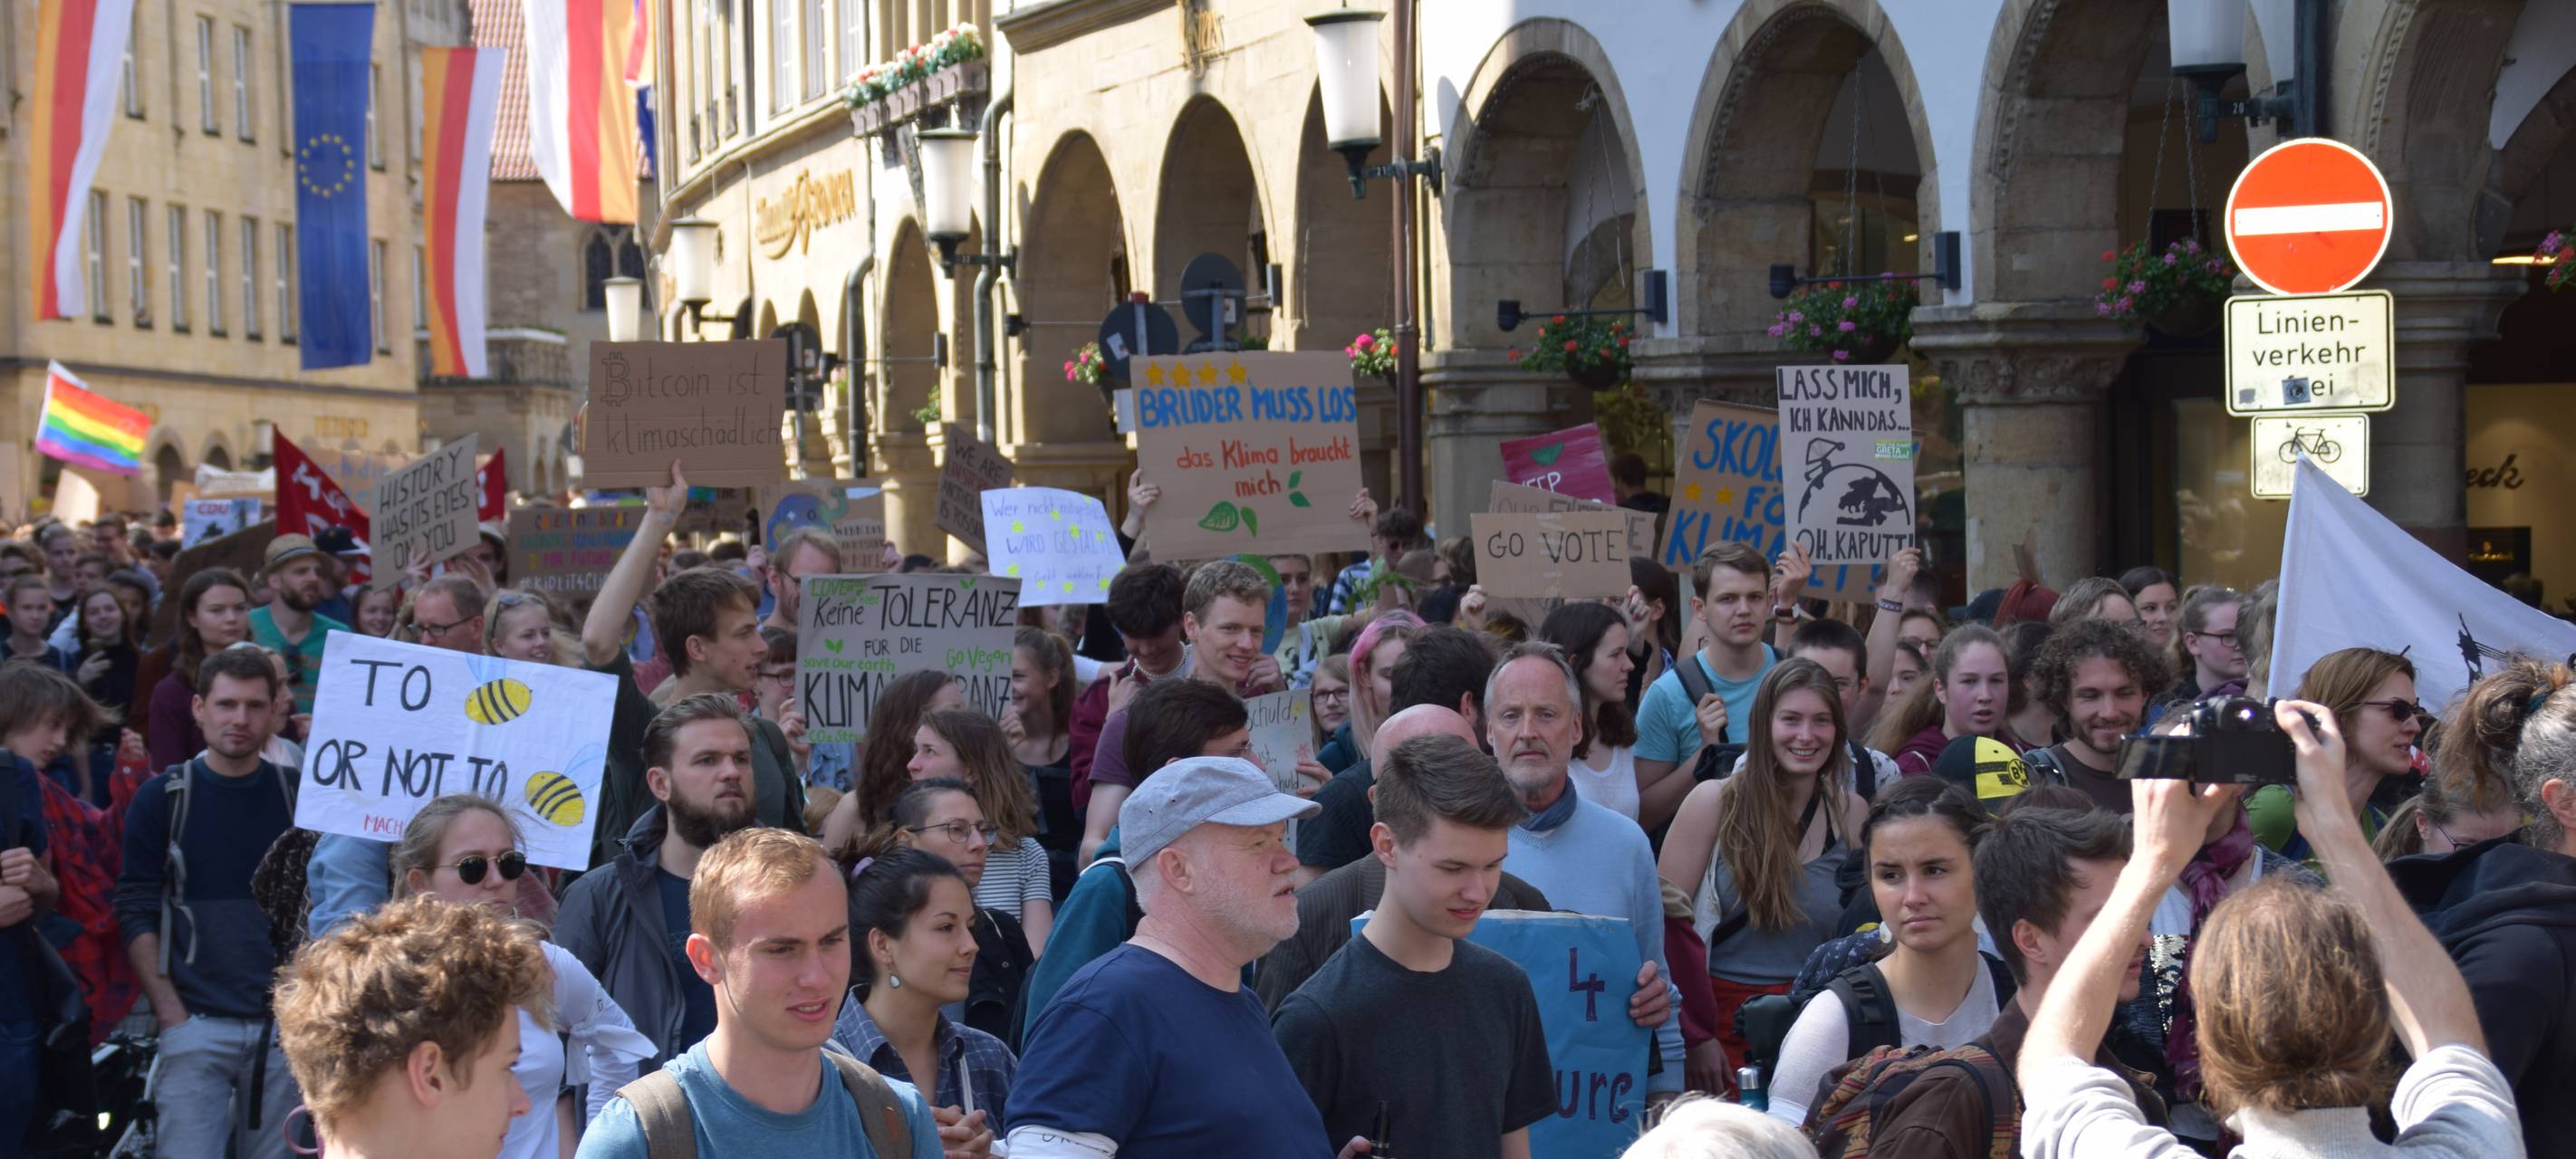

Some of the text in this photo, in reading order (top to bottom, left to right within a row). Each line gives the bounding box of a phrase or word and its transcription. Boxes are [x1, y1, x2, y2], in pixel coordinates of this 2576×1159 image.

[2258, 310, 2360, 335] Linien-
[2253, 340, 2367, 367] verkehr
[601, 351, 764, 407] Bitcoin ist
[1777, 368, 1902, 404] LASS MICH,
[2288, 373, 2334, 397] ei
[1139, 380, 1358, 428] BRUDER MUSS LOS
[1789, 407, 1910, 432] ICH KANN DAS...
[954, 436, 1004, 485] WE ARE
[1177, 435, 1352, 470] das Klima braucht
[380, 446, 463, 514] HISTORY
[1235, 469, 1283, 498] mich
[380, 479, 469, 545] HAS ITS EYES
[990, 495, 1019, 517] Wer
[1027, 495, 1054, 515] nicht
[1743, 485, 1786, 526] FÖ
[422, 519, 457, 558] YOU
[1006, 533, 1044, 554] WIRD
[1487, 528, 1624, 564] GO VOTE
[813, 597, 865, 628] Keine
[871, 584, 1018, 630] TOLERANZ
[803, 657, 895, 673] save our earth
[864, 637, 922, 658] FÜR DIE
[946, 645, 1013, 673] Go Vegan
[351, 658, 432, 712] TO
[312, 738, 508, 803] OR NOT TO
[1569, 946, 1605, 1022] 4
[1555, 1070, 1634, 1124] ure
